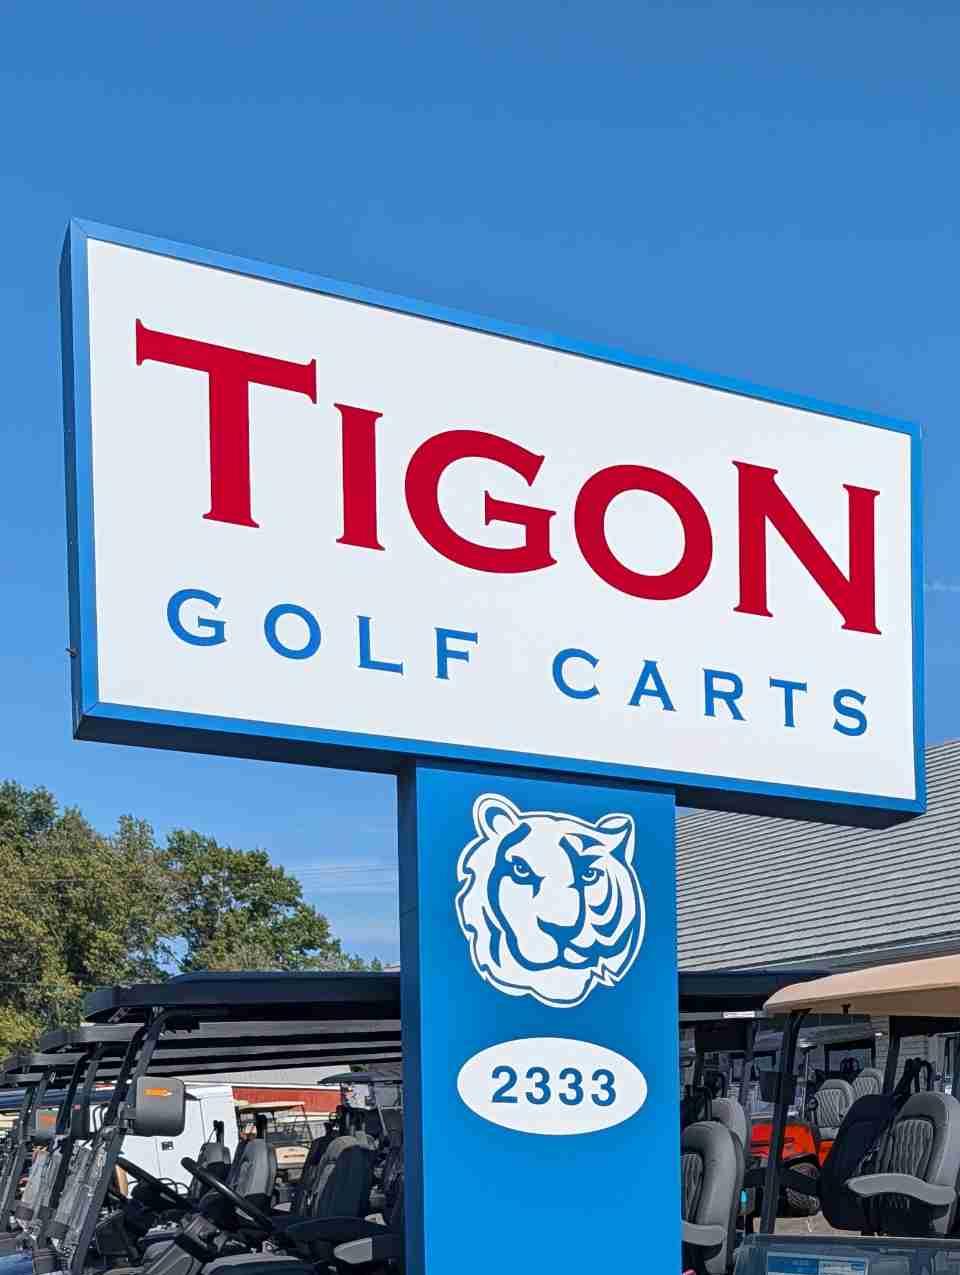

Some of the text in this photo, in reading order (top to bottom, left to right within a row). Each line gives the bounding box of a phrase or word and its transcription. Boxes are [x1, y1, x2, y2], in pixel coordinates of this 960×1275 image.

[135, 319, 881, 635] TIGON
[166, 588, 869, 737] GOLF CARTS
[491, 1065, 617, 1107] 2333
